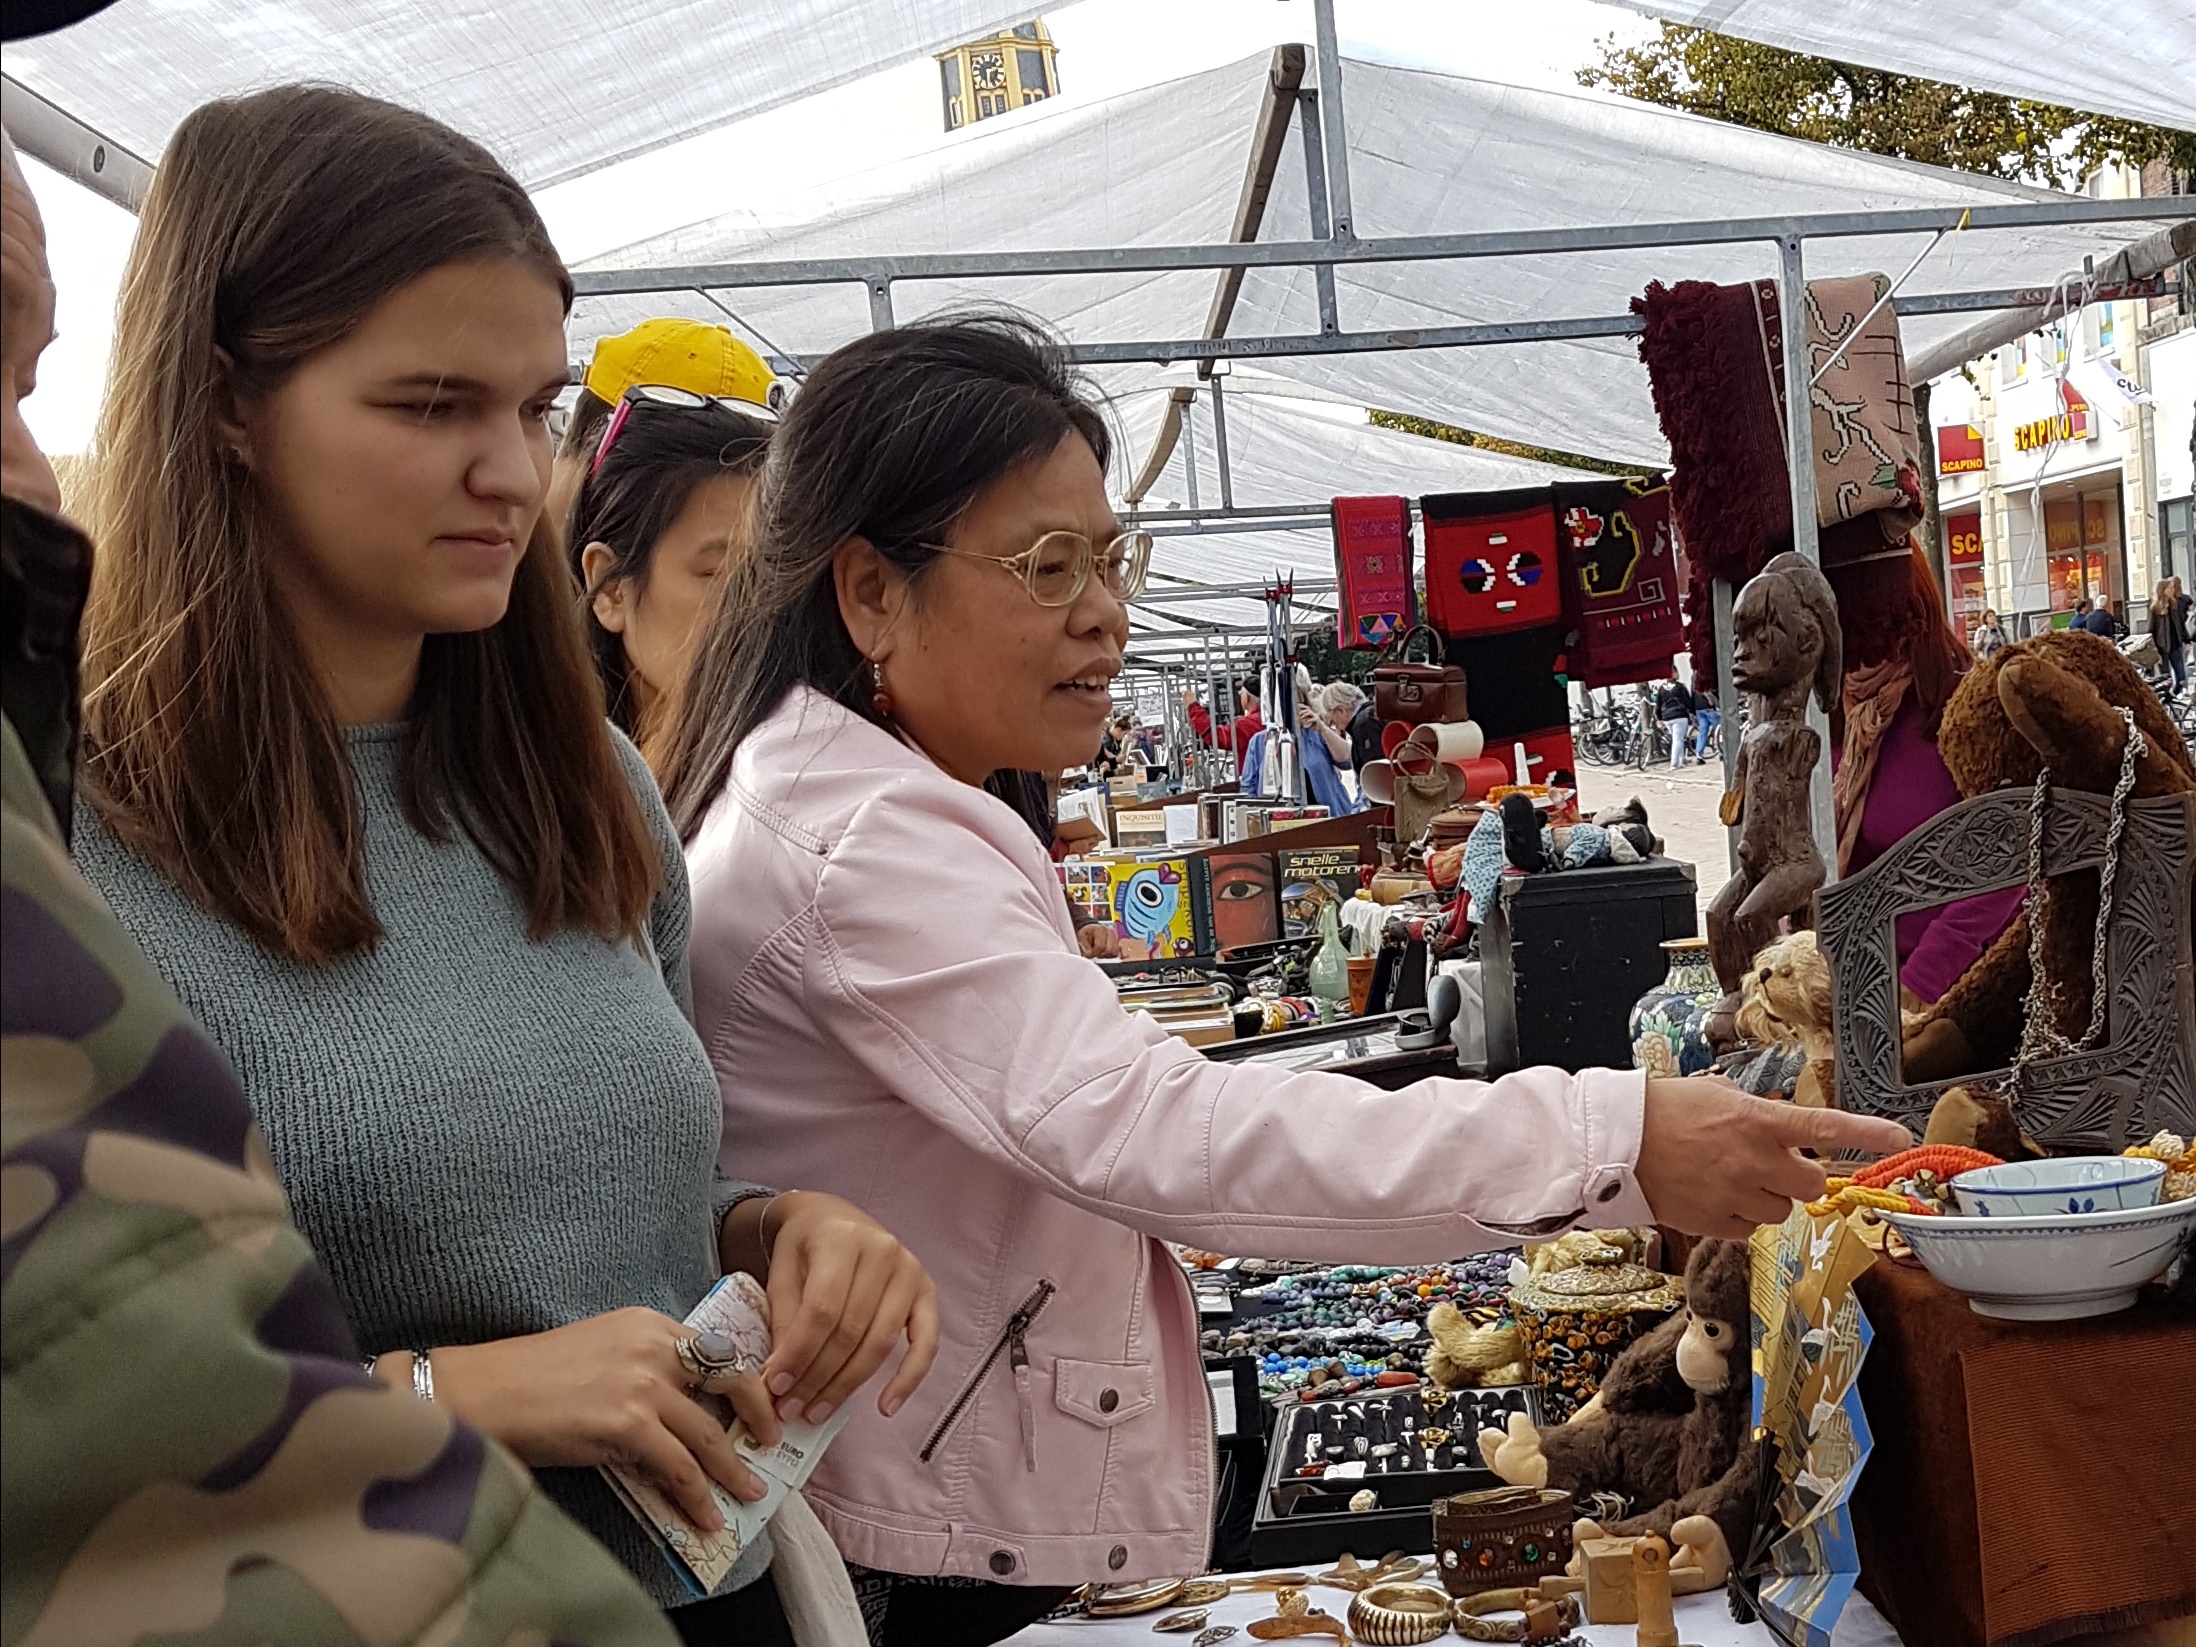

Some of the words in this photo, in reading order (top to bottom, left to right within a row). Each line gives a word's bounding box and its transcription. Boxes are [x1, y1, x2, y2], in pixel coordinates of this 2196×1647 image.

[2014, 414, 2070, 451] SCAPINO
[1941, 458, 1983, 472] SCAPINO
[1289, 853, 1340, 867] snelle
[1283, 864, 1358, 878] motoren
[780, 1441, 804, 1459] EURO
